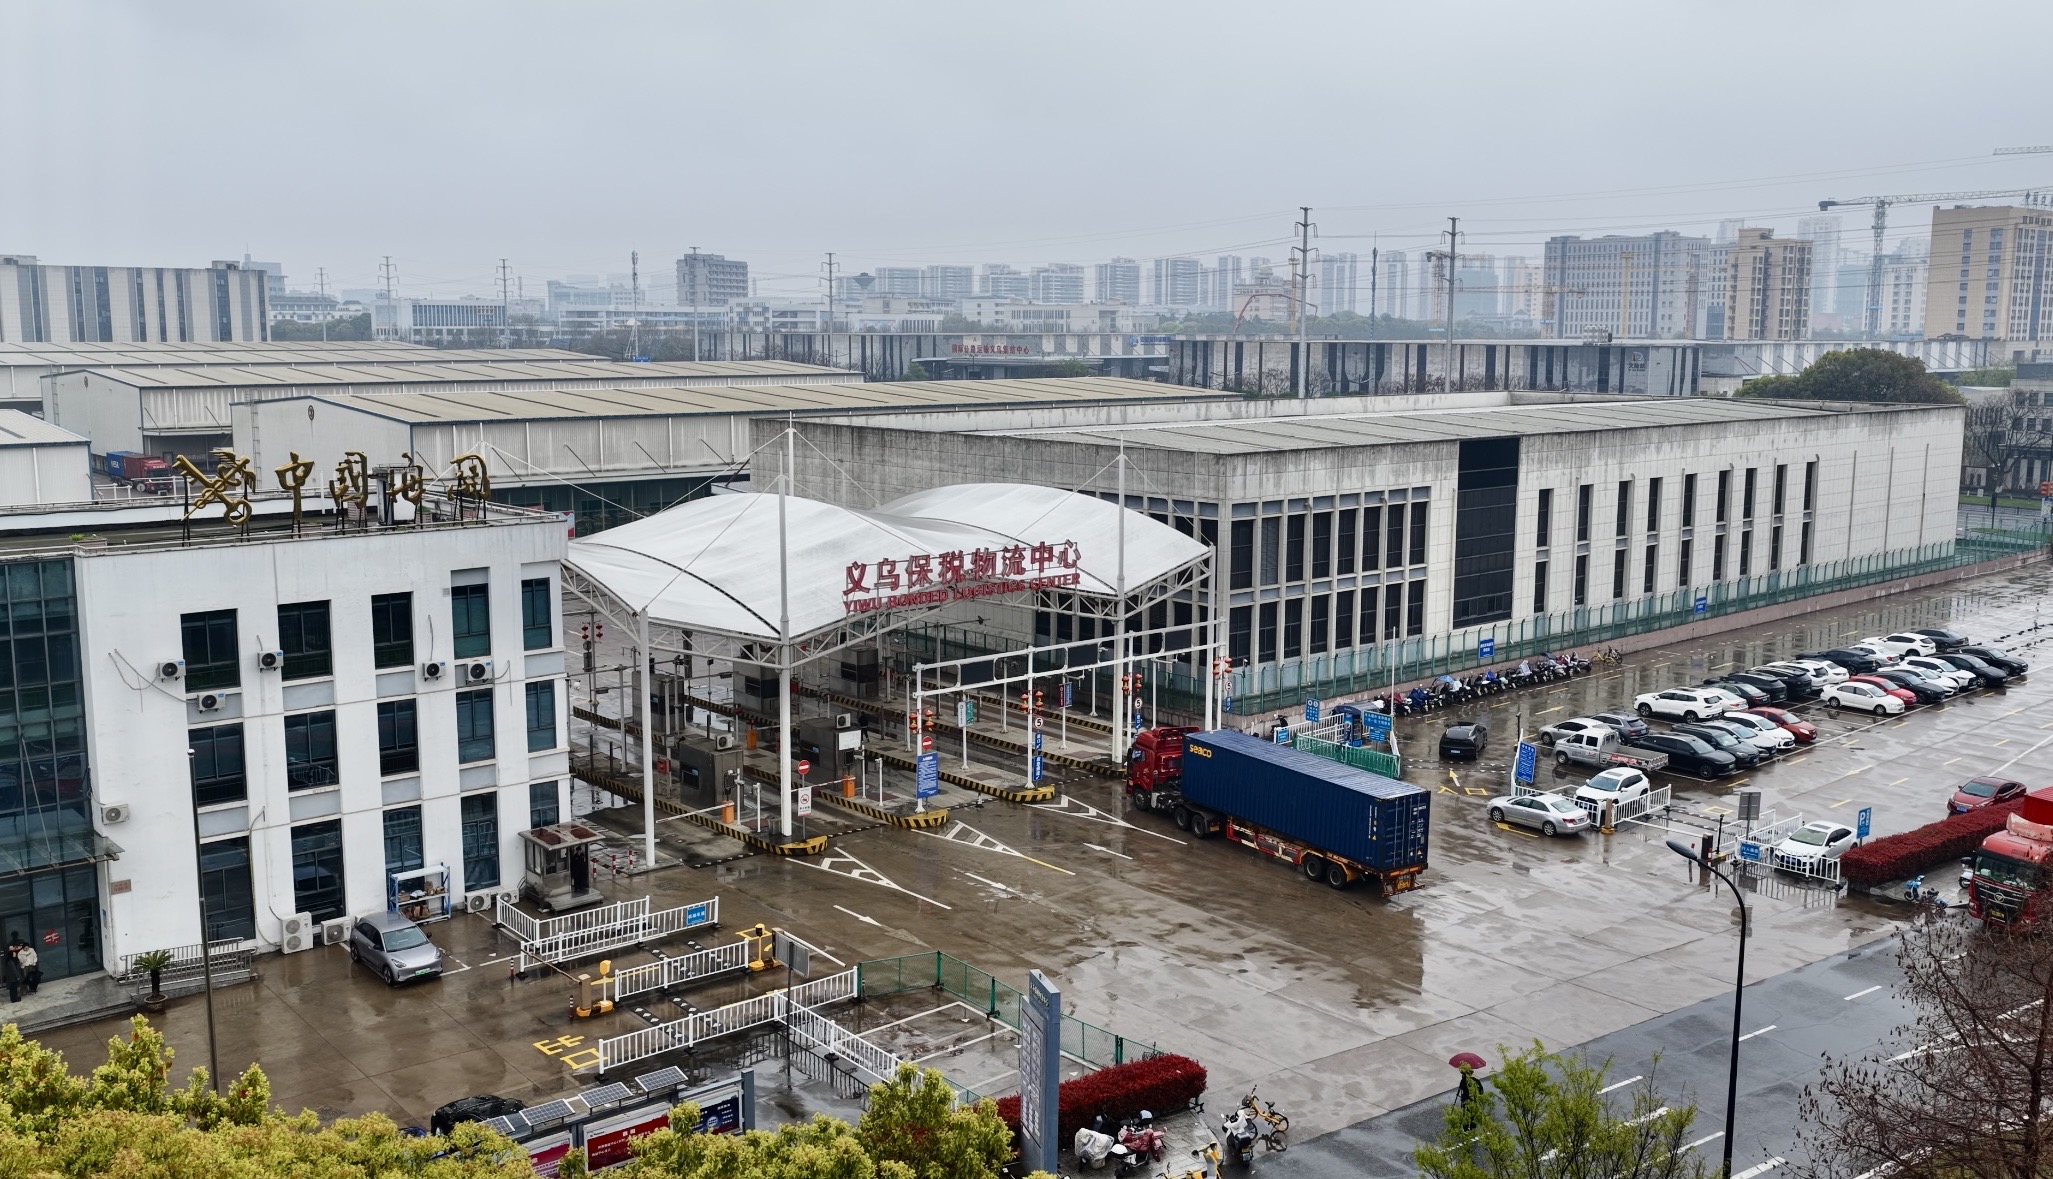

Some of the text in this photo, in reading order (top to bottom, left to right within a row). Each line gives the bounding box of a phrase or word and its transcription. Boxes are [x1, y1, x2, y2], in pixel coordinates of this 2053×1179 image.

[843, 539, 1082, 596] 义乌保税物流中心
[843, 572, 1081, 613] YIWU BONDED LOGISTICS CENTER
[1189, 744, 1212, 758] seaco
[1860, 811, 1866, 826] P
[533, 1034, 608, 1070] 出口
